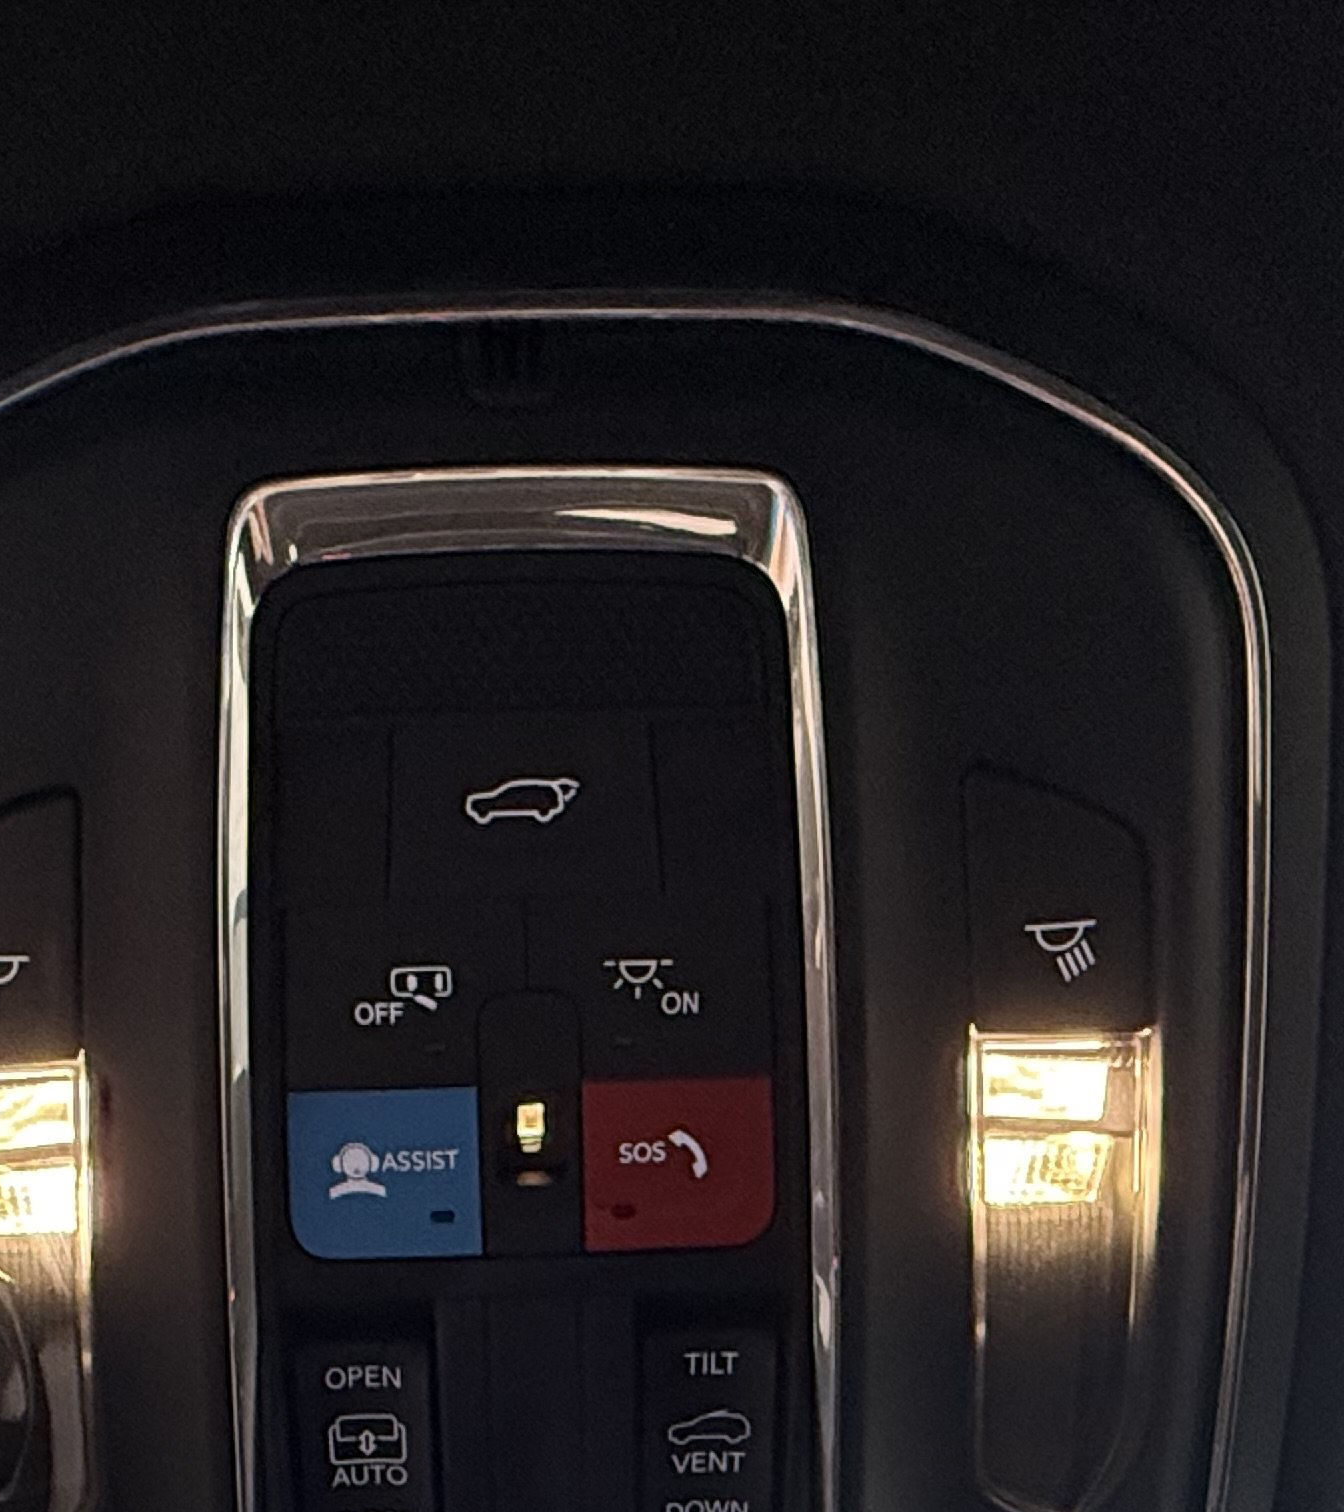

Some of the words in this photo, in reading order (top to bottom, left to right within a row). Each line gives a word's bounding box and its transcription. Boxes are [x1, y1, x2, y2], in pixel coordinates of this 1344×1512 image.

[354, 1003, 404, 1026] OFF
[661, 992, 700, 1015] ON
[381, 1149, 460, 1172] ASSIST
[618, 1141, 666, 1165] SOS
[684, 1351, 739, 1376] TILT
[325, 1366, 402, 1390] OPEN
[671, 1451, 746, 1475] VENT
[332, 1466, 408, 1488] AUTO
